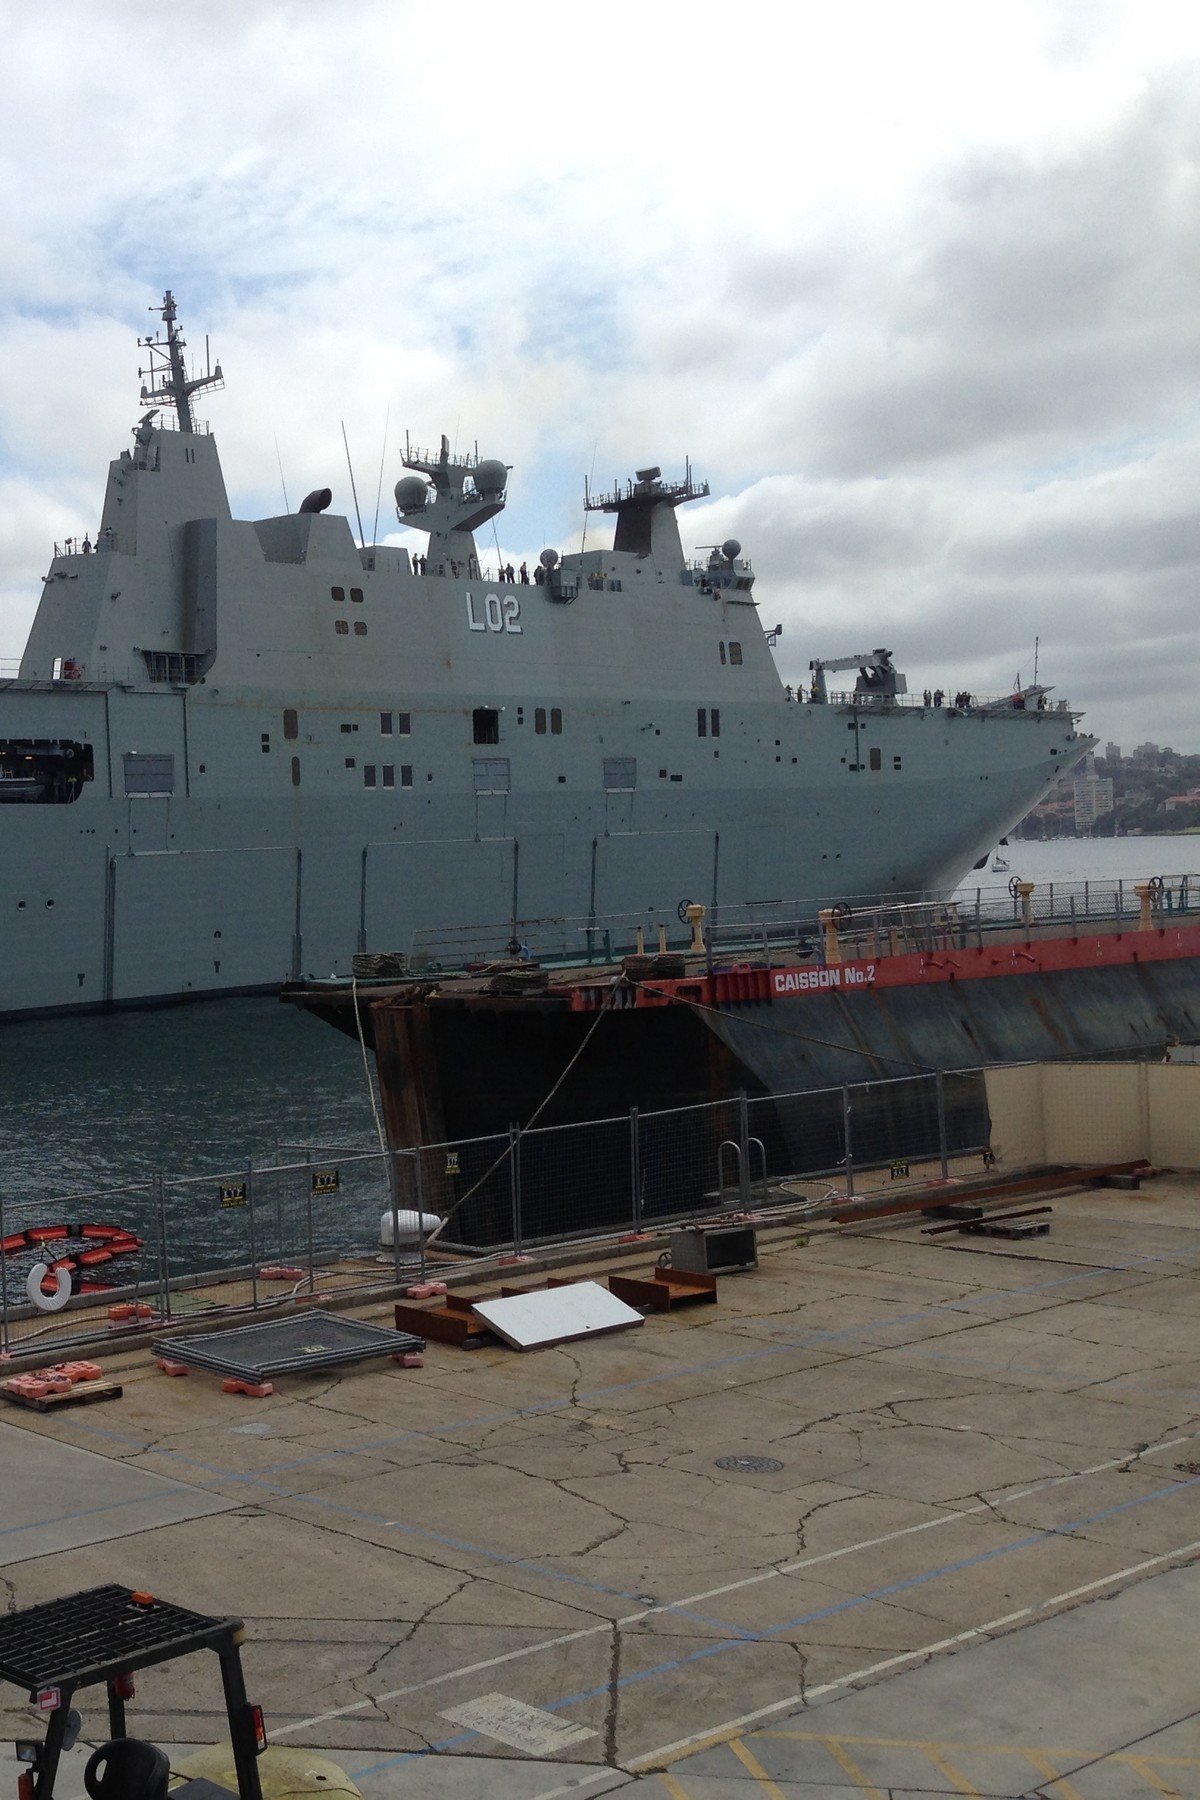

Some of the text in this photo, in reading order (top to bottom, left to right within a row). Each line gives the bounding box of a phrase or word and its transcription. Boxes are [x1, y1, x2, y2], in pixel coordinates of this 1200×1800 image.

[465, 591, 522, 633] L02
[774, 964, 876, 992] CAISSON No.2
